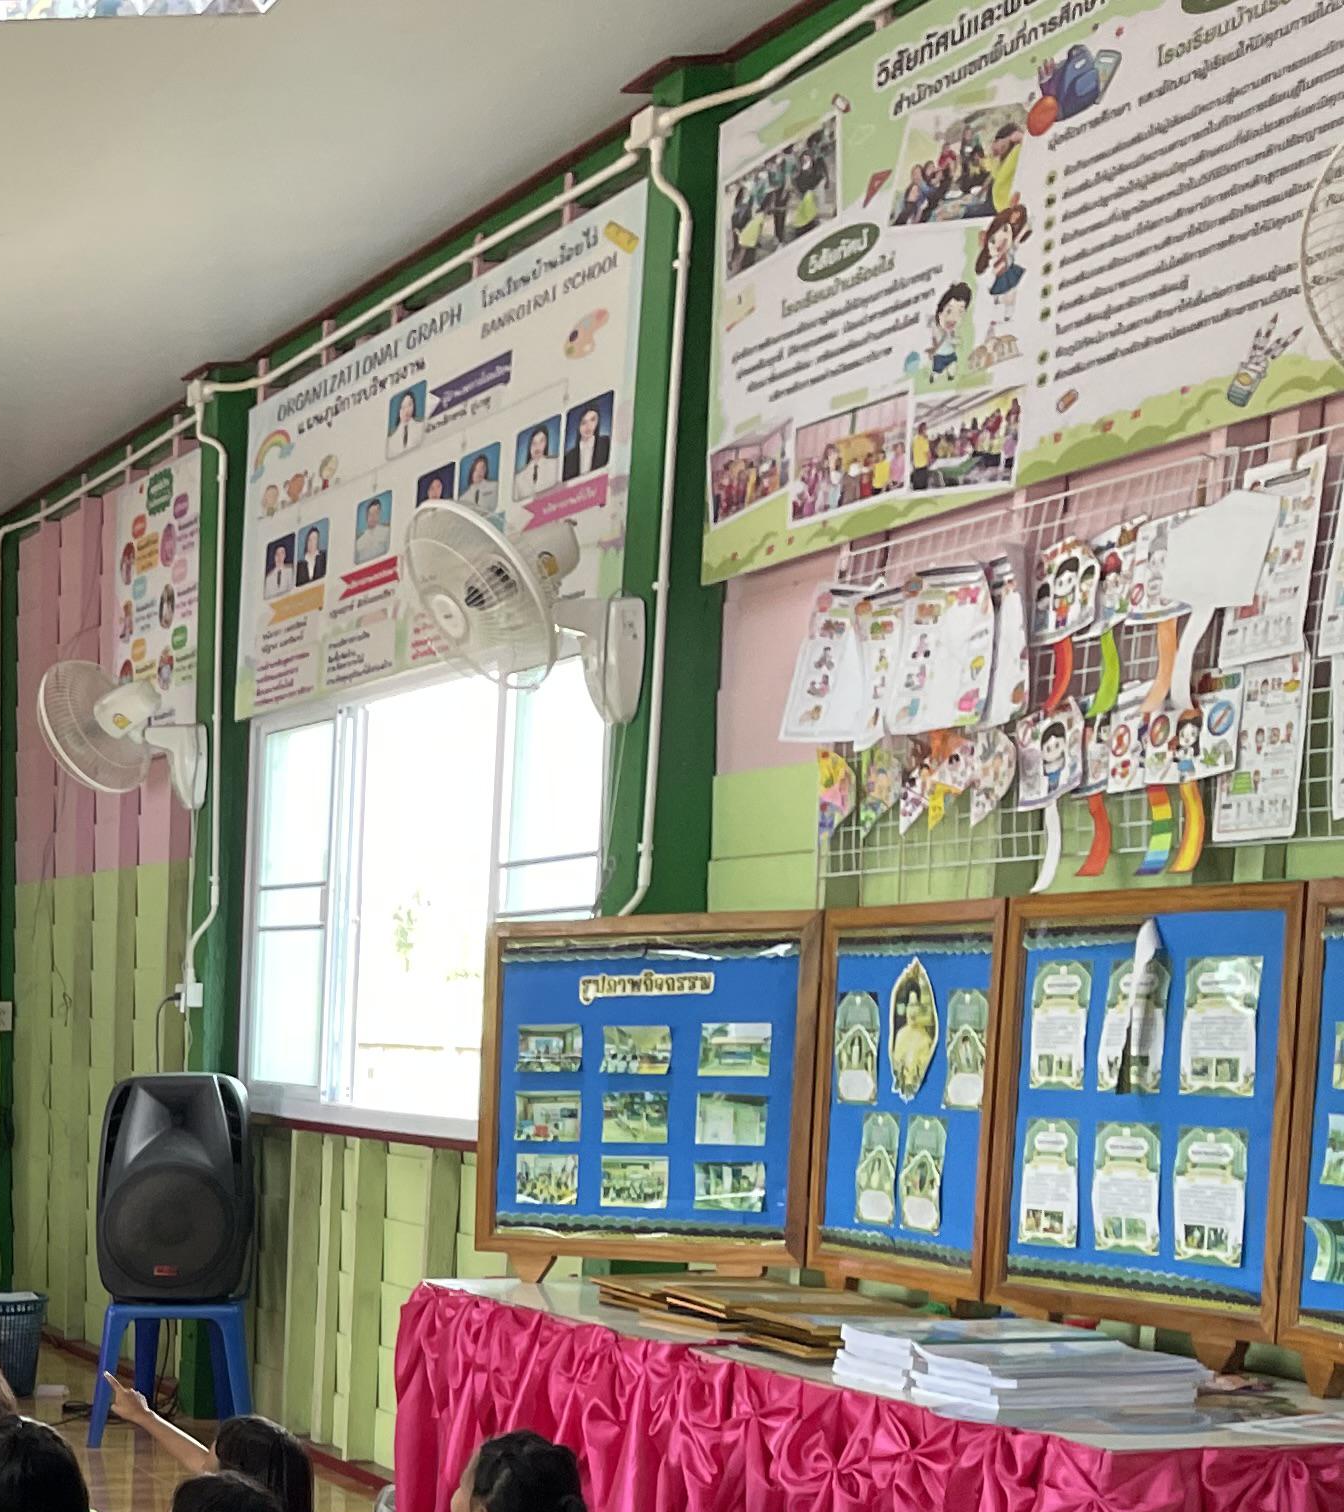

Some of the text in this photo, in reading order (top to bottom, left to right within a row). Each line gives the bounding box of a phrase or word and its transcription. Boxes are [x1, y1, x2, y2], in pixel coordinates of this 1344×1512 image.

[481, 252, 618, 340] BANROIRAI SCHOOL
[277, 338, 400, 422] ORGANIZATIONAL
[406, 303, 462, 350] GRAPH
